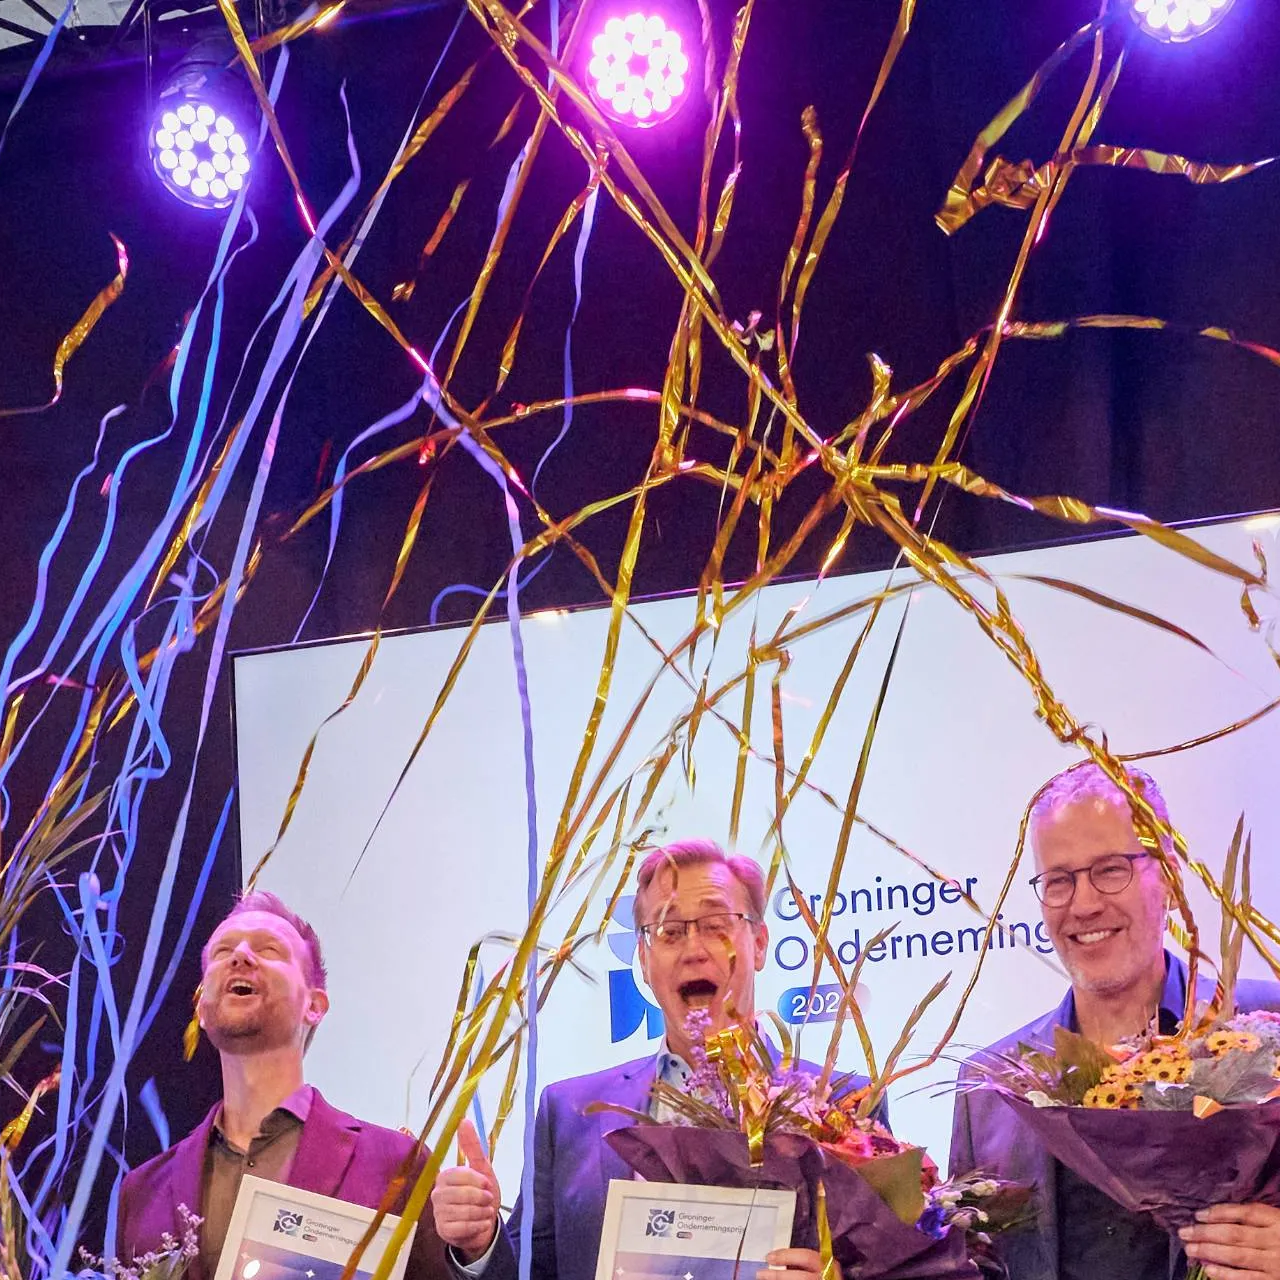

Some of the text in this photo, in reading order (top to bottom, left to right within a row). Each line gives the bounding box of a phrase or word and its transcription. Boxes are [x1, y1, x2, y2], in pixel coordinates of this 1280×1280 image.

[773, 876, 978, 921] Groninger
[774, 914, 1054, 971] Oderneming
[791, 991, 852, 1017] 202
